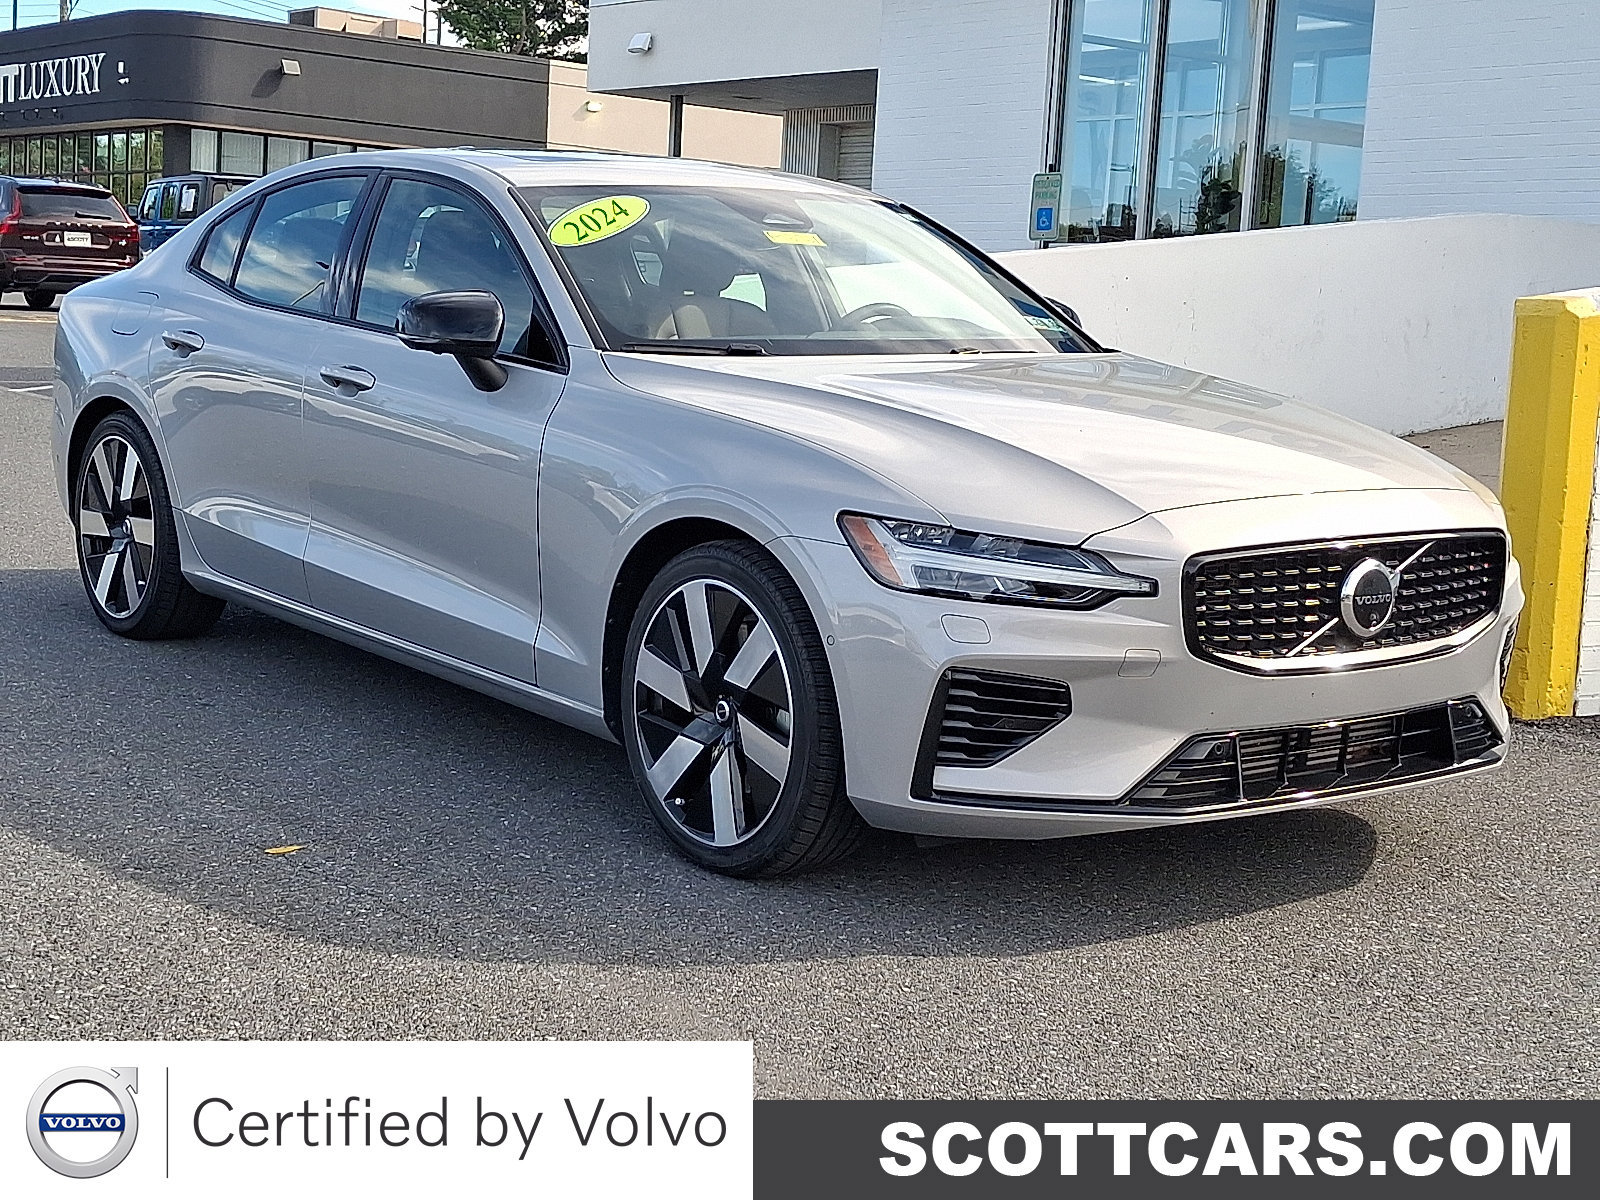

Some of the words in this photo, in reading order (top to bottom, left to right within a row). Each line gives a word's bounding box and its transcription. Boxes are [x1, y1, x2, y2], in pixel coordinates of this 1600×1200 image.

[18, 52, 106, 101] LUXURY
[564, 199, 630, 242] 2024
[1355, 593, 1392, 606] VOLVO
